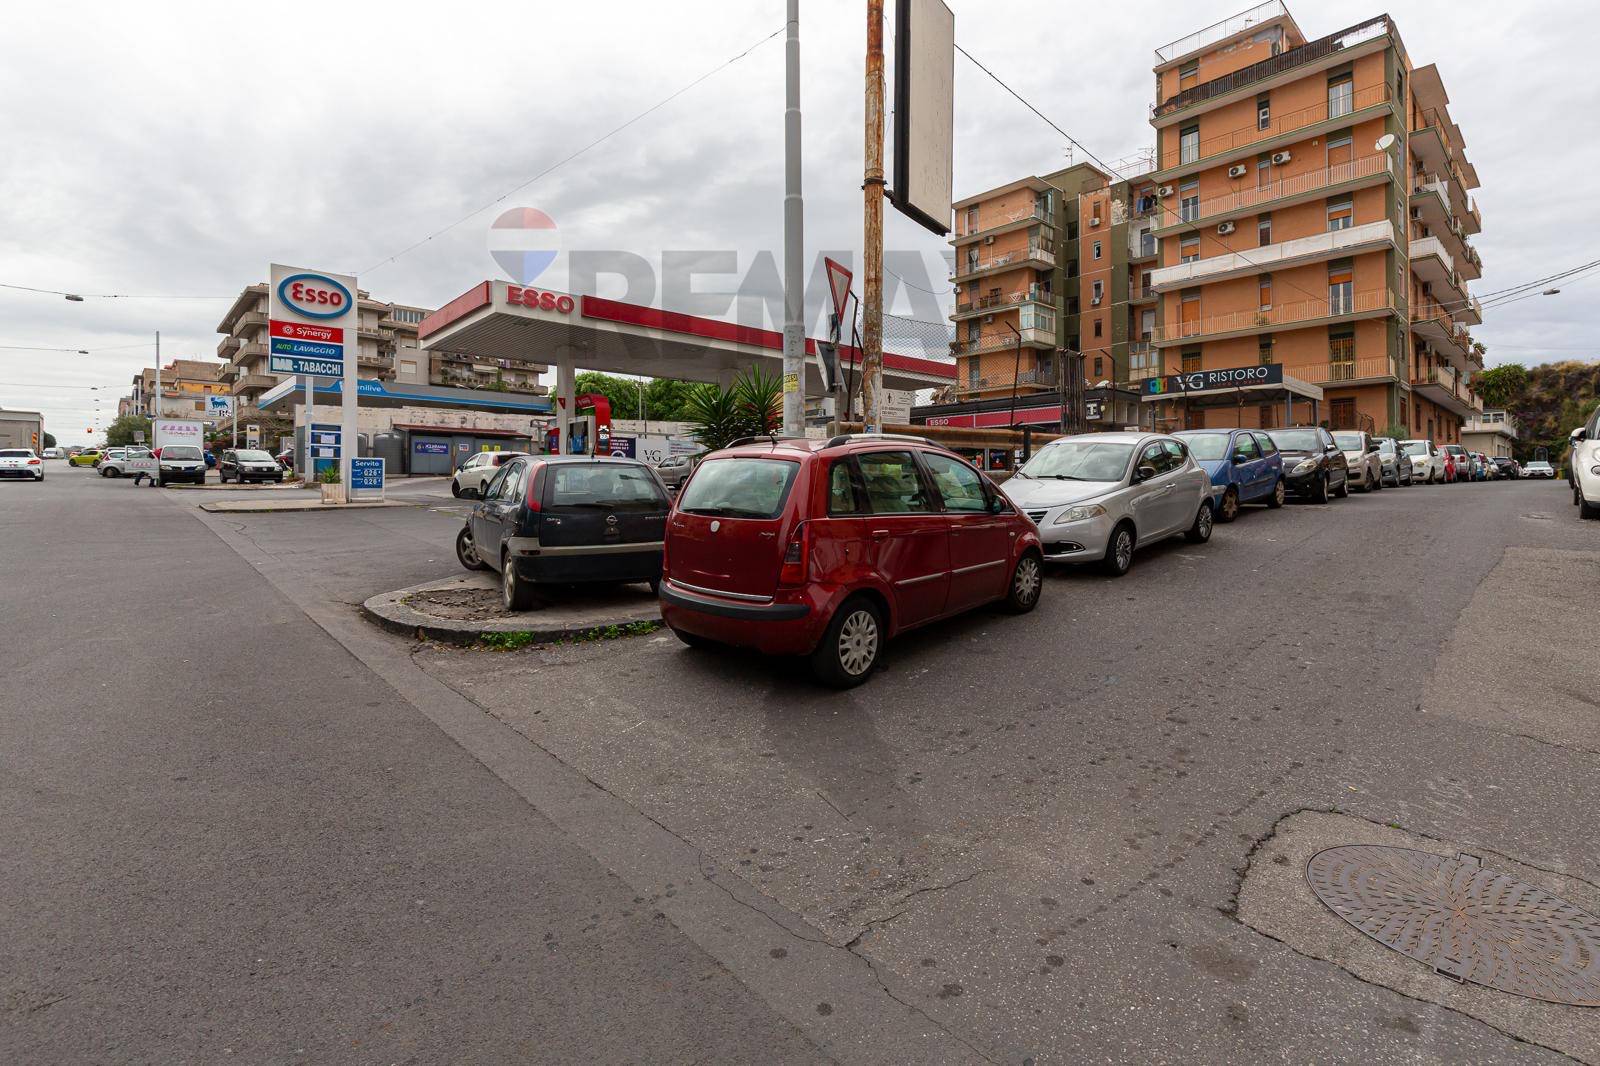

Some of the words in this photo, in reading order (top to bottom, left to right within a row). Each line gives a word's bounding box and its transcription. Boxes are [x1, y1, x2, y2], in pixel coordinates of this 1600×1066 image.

[505, 284, 576, 315] ESSO
[296, 327, 332, 340] Synergy
[275, 343, 292, 351] AUTO
[294, 345, 335, 355] LAVAGGIO
[298, 360, 341, 375] TABACCHI
[1175, 373, 1205, 391] VG
[1208, 367, 1268, 384] RISTORO
[929, 418, 949, 427] ESSO
[643, 449, 662, 463] VG
